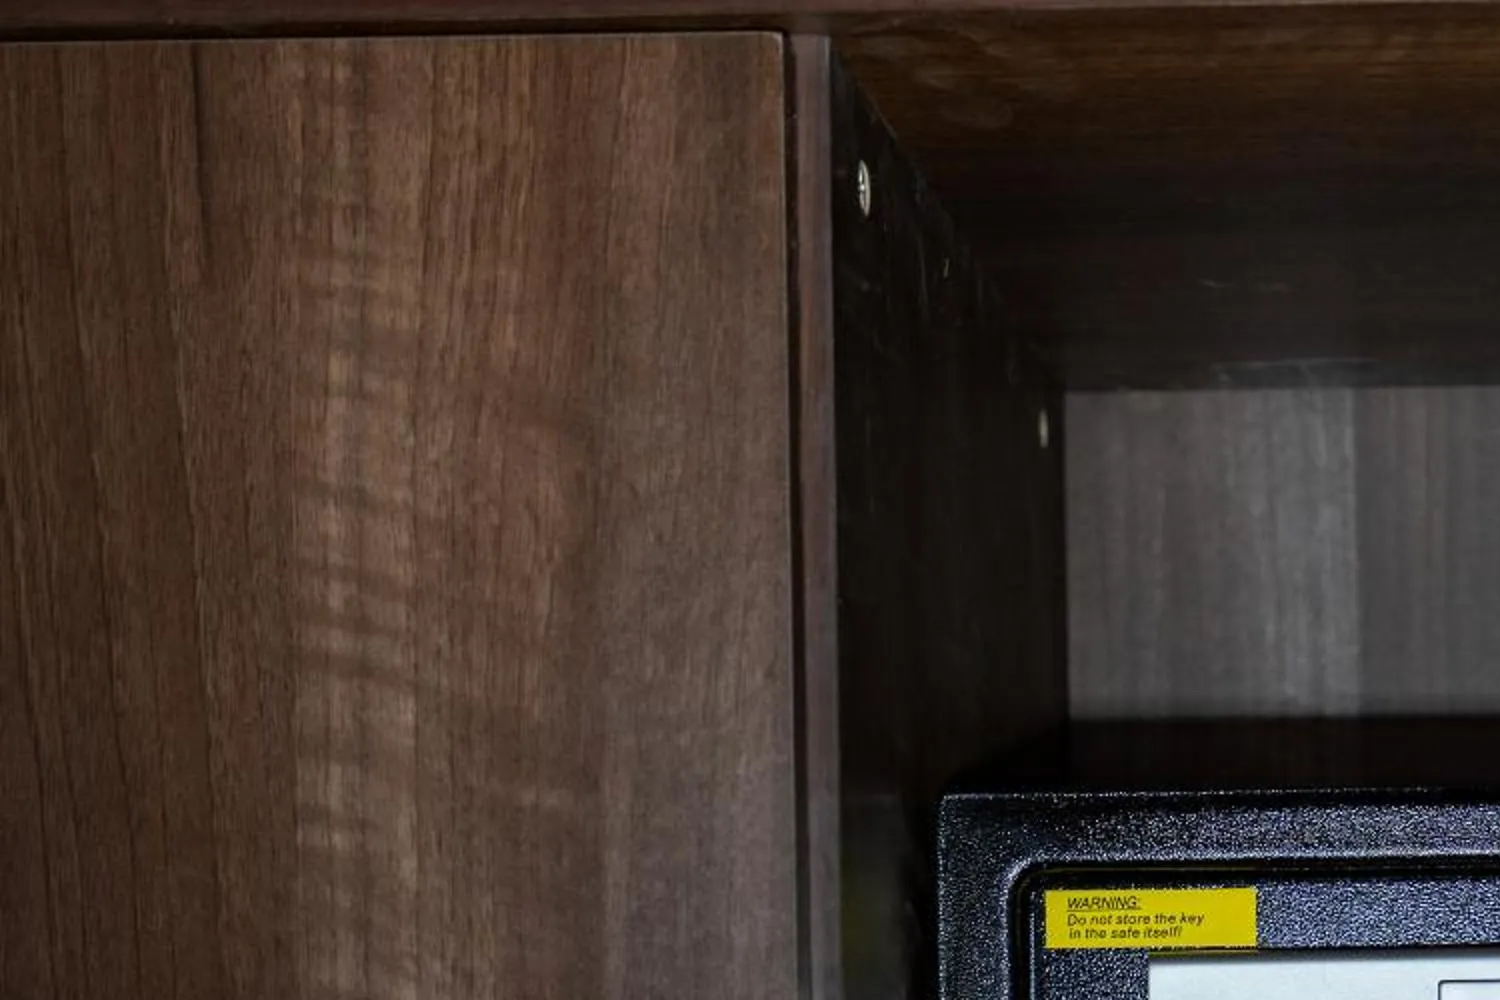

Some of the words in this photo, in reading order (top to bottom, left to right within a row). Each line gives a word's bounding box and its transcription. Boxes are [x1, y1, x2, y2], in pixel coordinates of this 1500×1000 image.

[1067, 913, 1087, 926] Do
[1090, 914, 1113, 925] not
[1115, 914, 1151, 925] store
[1155, 913, 1177, 924] the
[1180, 912, 1205, 926] key
[1085, 928, 1107, 939] the
[1110, 926, 1140, 939] safe
